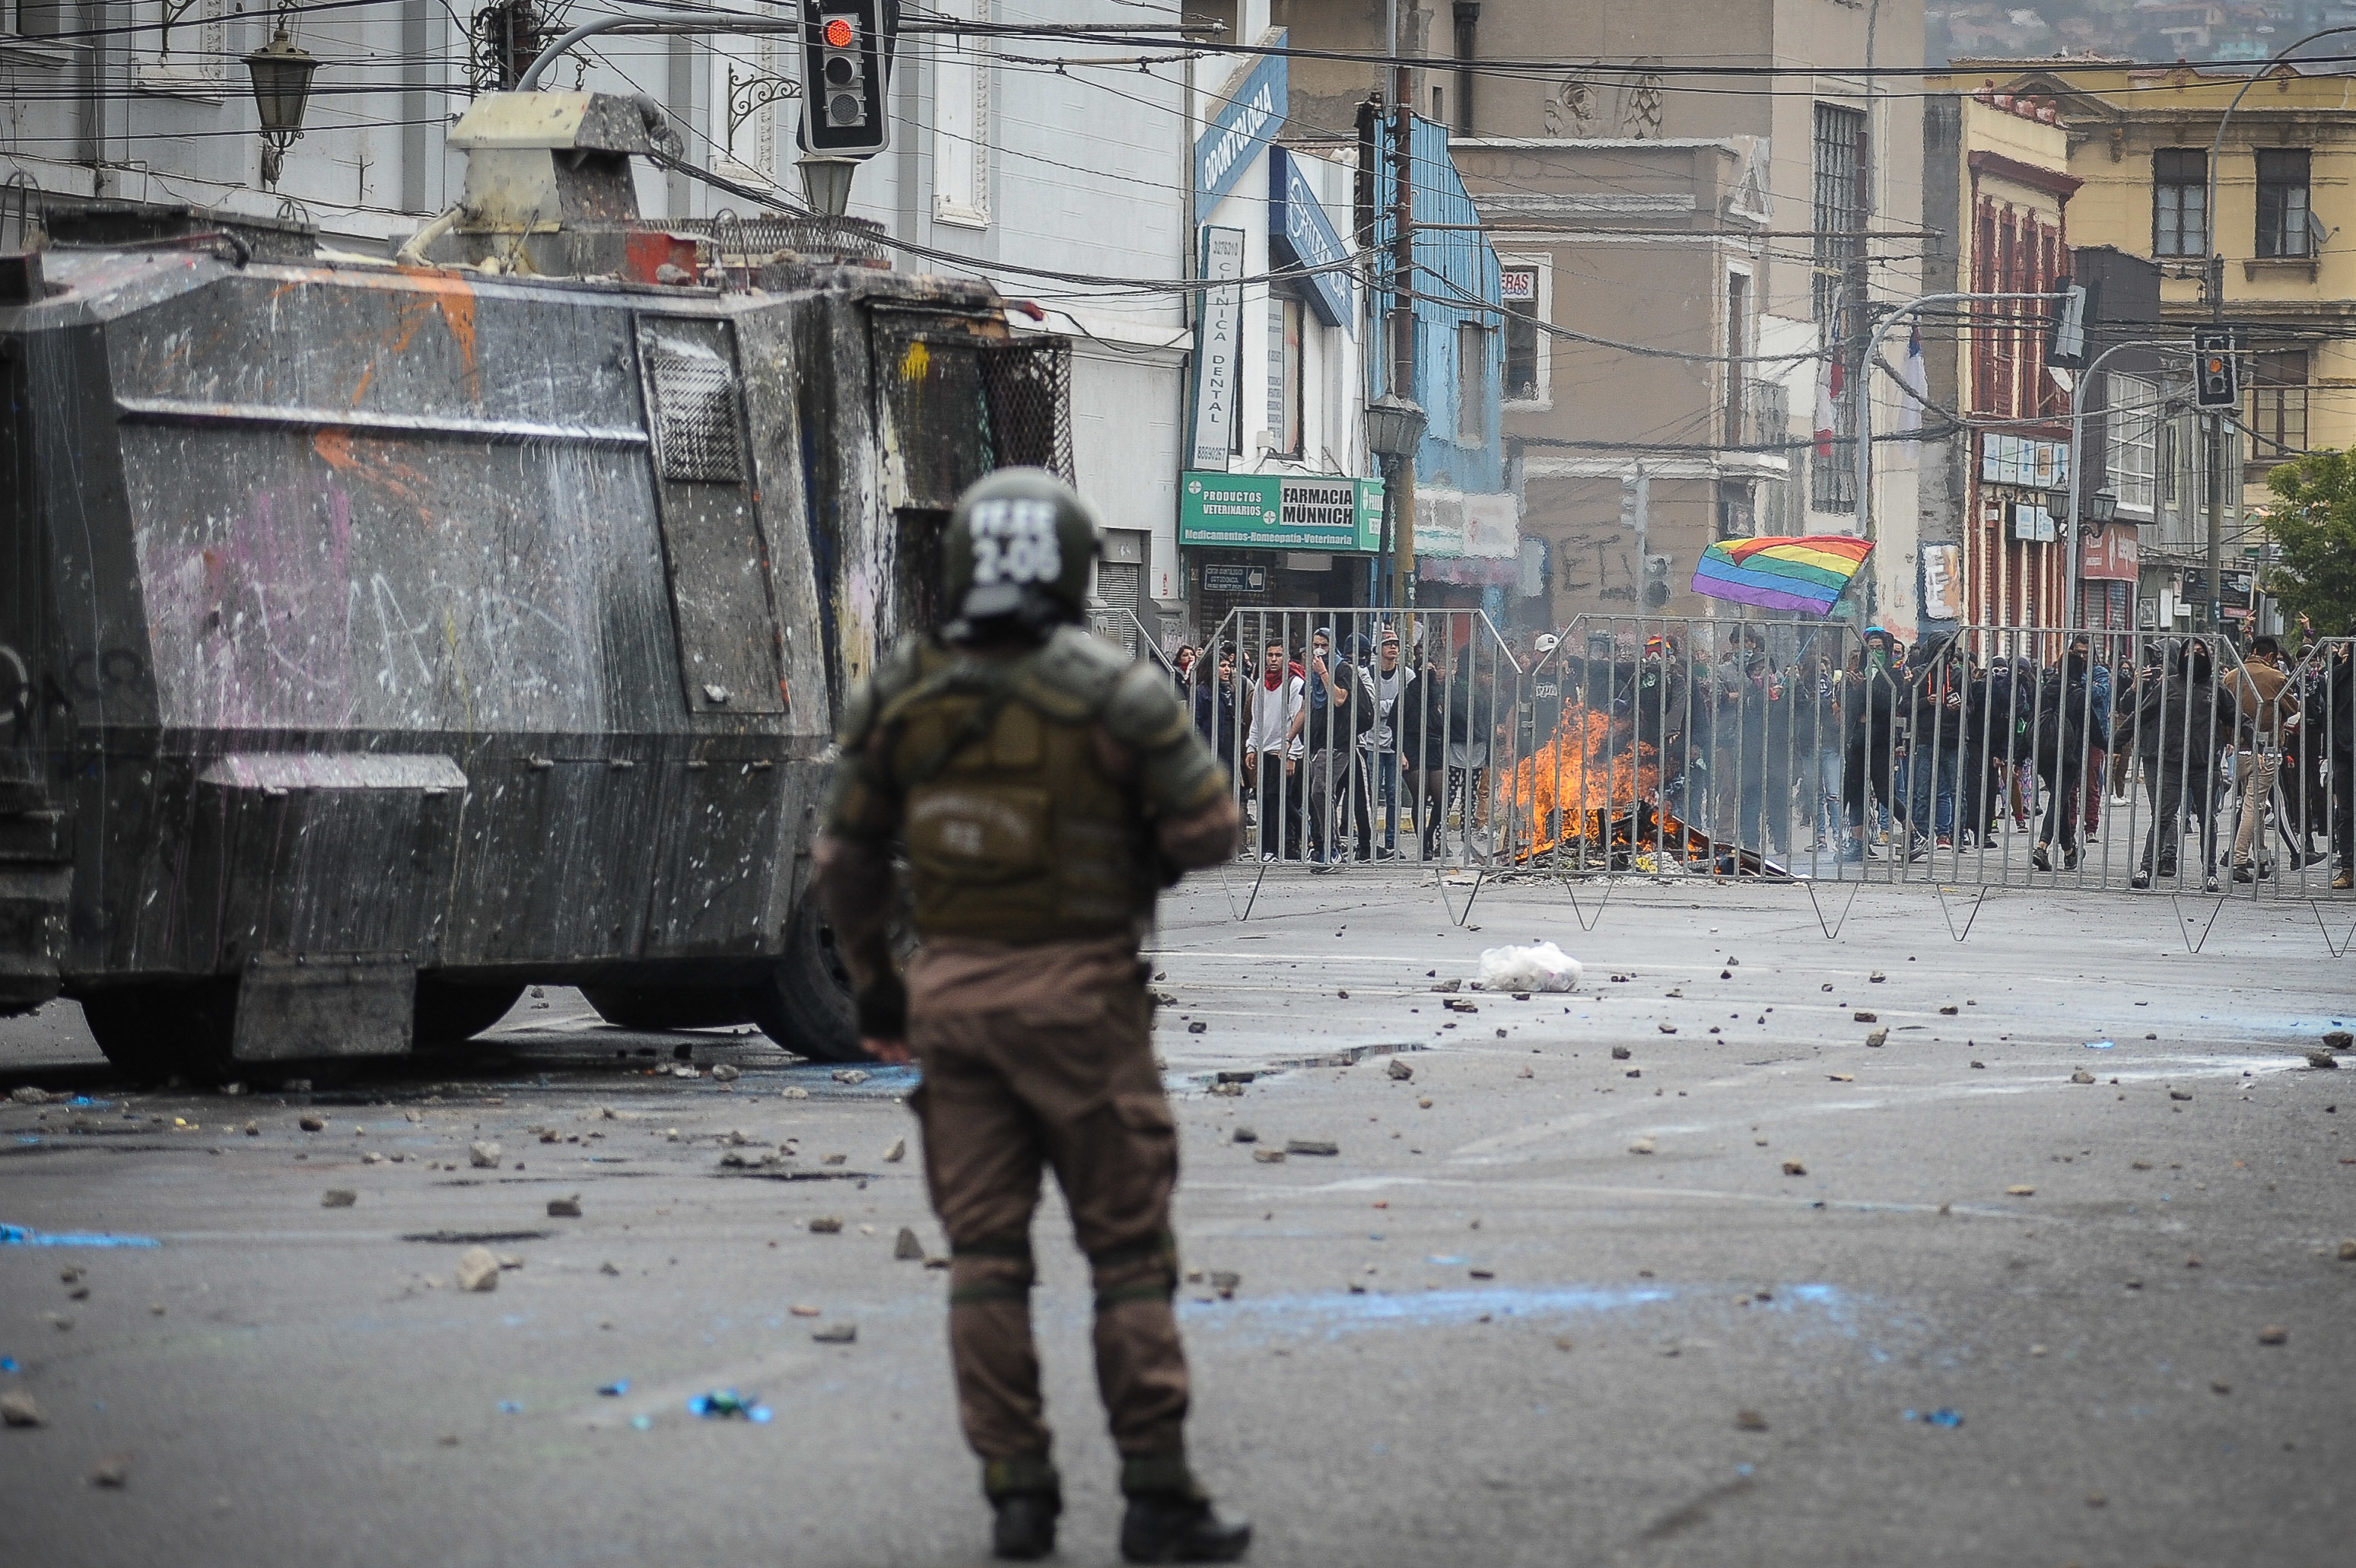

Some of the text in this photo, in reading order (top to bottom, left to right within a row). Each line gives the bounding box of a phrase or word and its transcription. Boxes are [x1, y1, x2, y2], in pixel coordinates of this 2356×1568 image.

[1204, 81, 1273, 191] ODONTOLOGIA
[1208, 355, 1226, 423] DENTAL
[1203, 491, 1262, 503] PRODUCTOS
[1283, 487, 1353, 505] FARMACIA
[1203, 504, 1261, 517] VETERINARIOS
[1283, 504, 1353, 525] MÜNNICH
